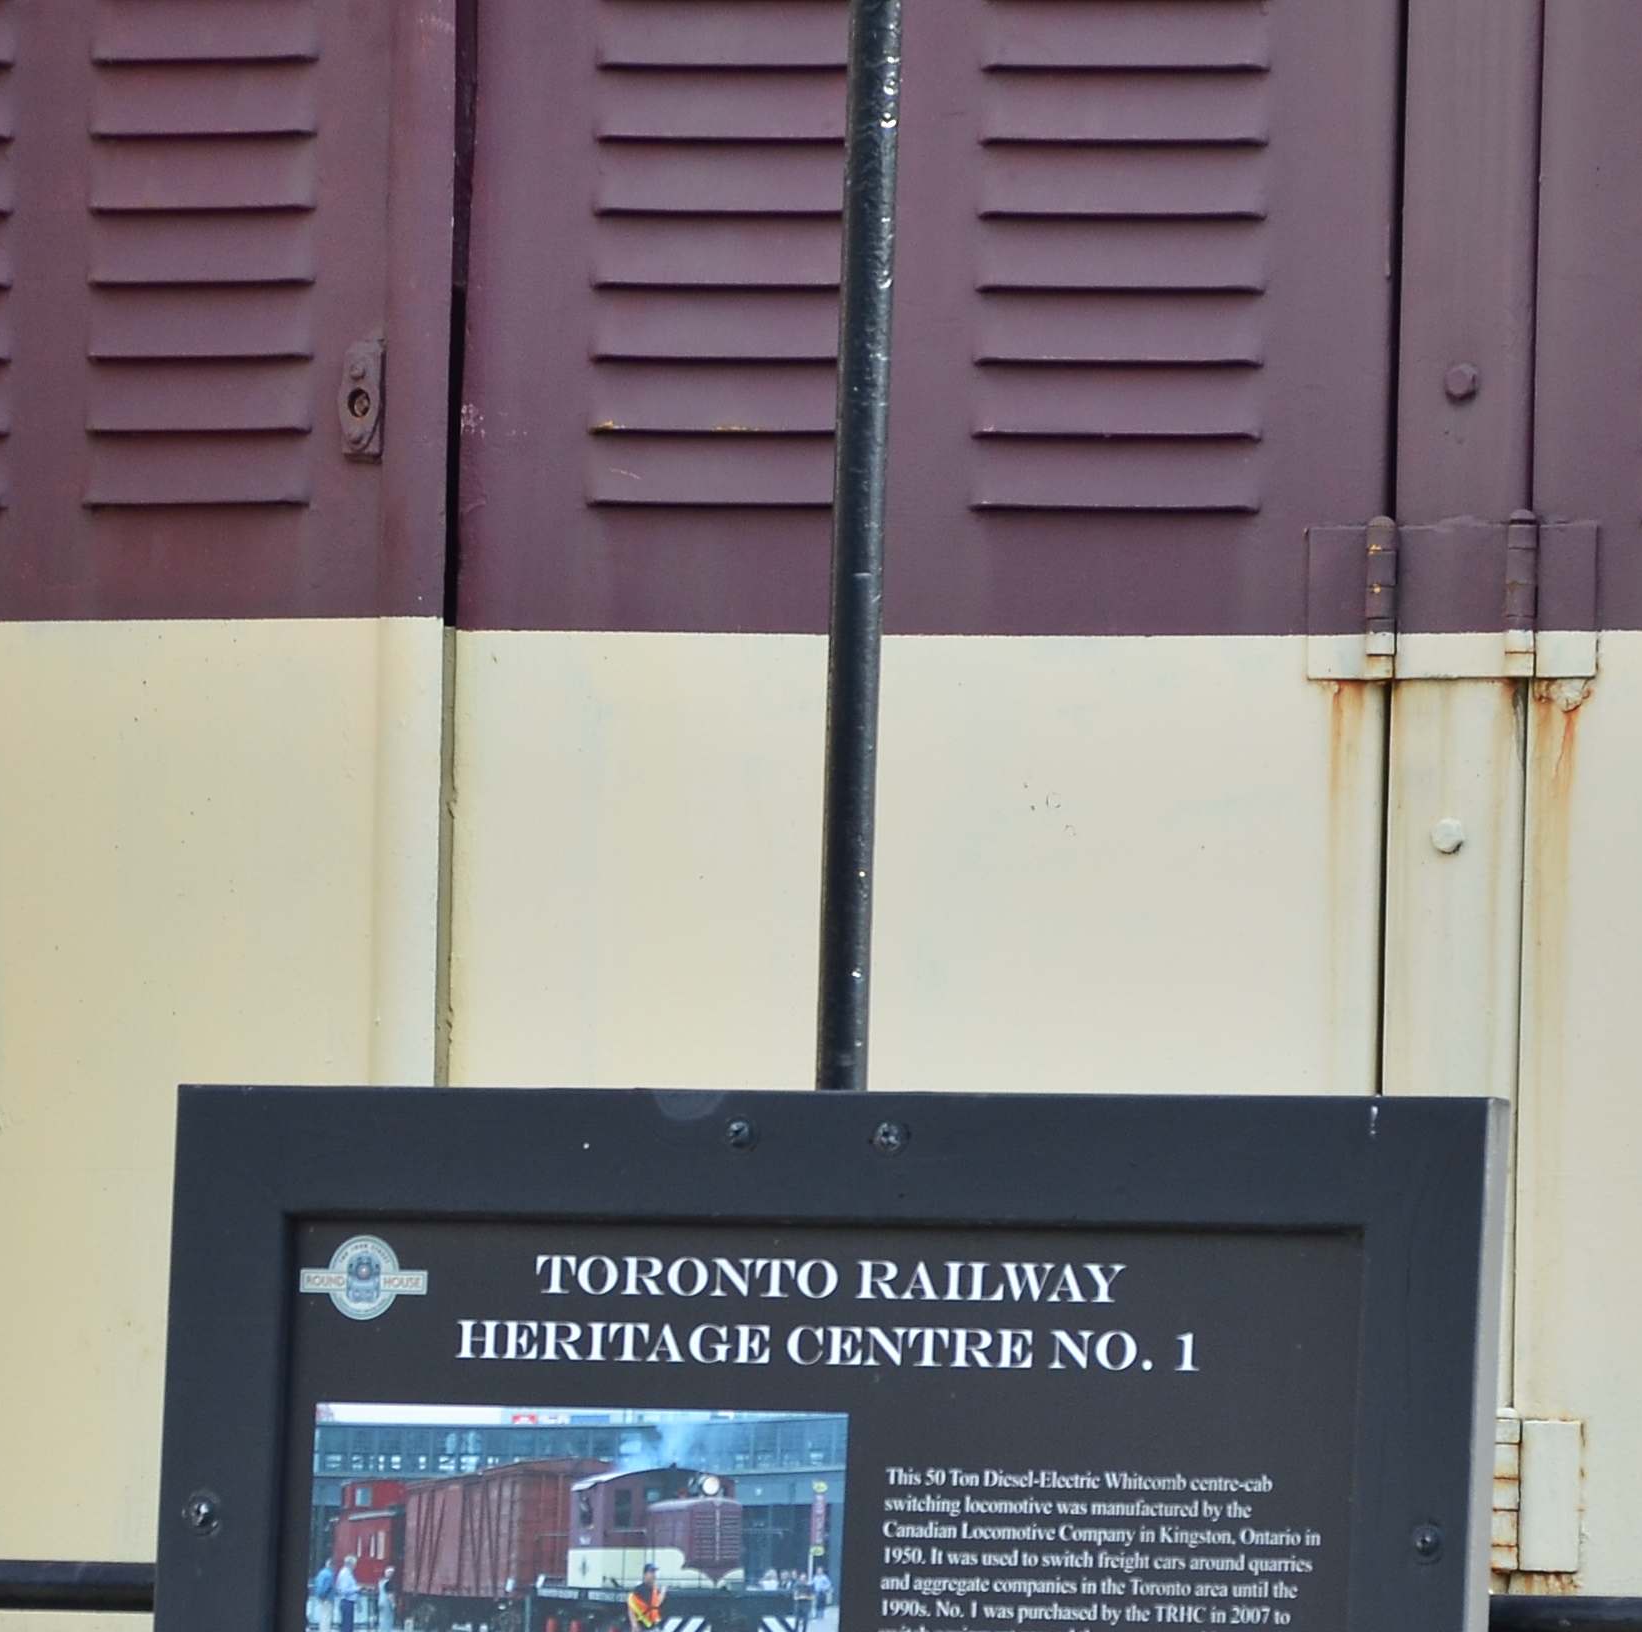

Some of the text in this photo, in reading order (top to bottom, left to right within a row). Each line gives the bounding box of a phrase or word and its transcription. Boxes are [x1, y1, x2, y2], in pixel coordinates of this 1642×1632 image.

[305, 1274, 423, 1289] ROUND HOUSE
[535, 1254, 1127, 1303] TORONTO RAILWAY
[455, 1319, 1200, 1372] HERITAGE CENTRE NO. 1
[885, 1466, 1274, 1493] This 50 Ton Diesel-Electric Whitcomb centre-cab
[883, 1493, 1253, 1523] switching locomotive was manufactured by the
[881, 1519, 1322, 1549] Canadian Locomotive Company in Kingston, Ontario in
[883, 1545, 1314, 1577] 1950. It was used to switch freight cars around quarries
[879, 1571, 1299, 1599] and aggregate companies in the Toronto area until the
[881, 1598, 1292, 1626] 1990s. No. 1 was purchased by the TRHC in 2007 to
